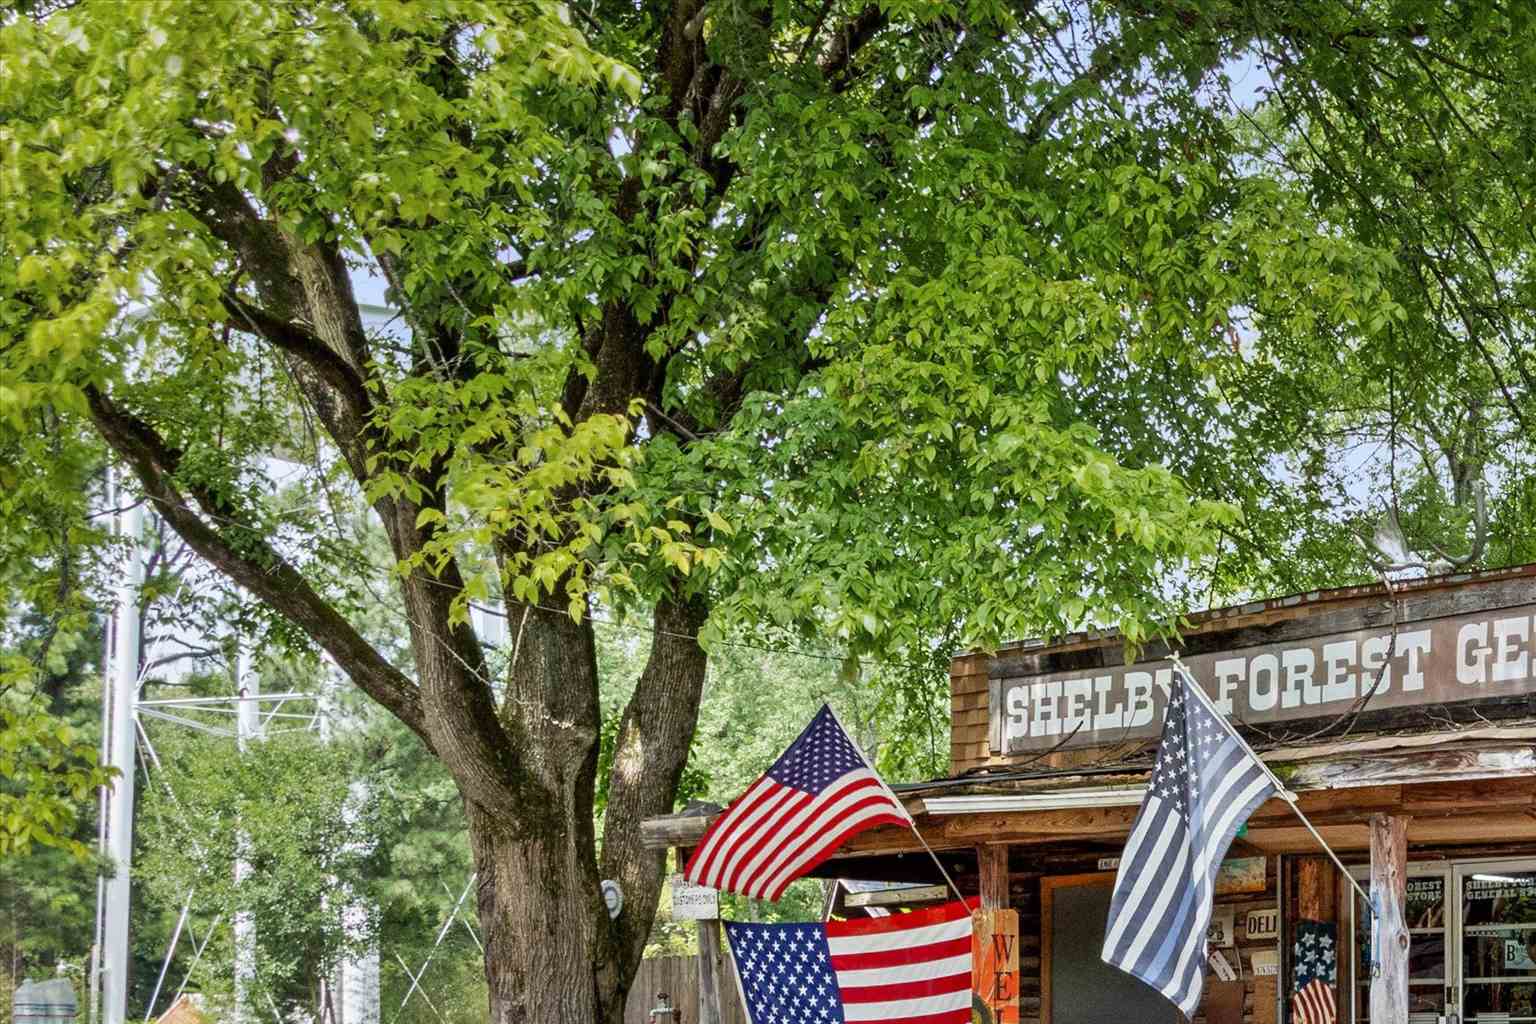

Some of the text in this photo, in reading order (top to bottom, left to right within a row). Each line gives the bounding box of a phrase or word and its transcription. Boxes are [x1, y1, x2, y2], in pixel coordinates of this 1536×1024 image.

[1214, 629, 1432, 716] FOREST
[1407, 881, 1442, 891] OREST
[1467, 888, 1518, 900] GENERAL
[1248, 915, 1277, 935] DELI
